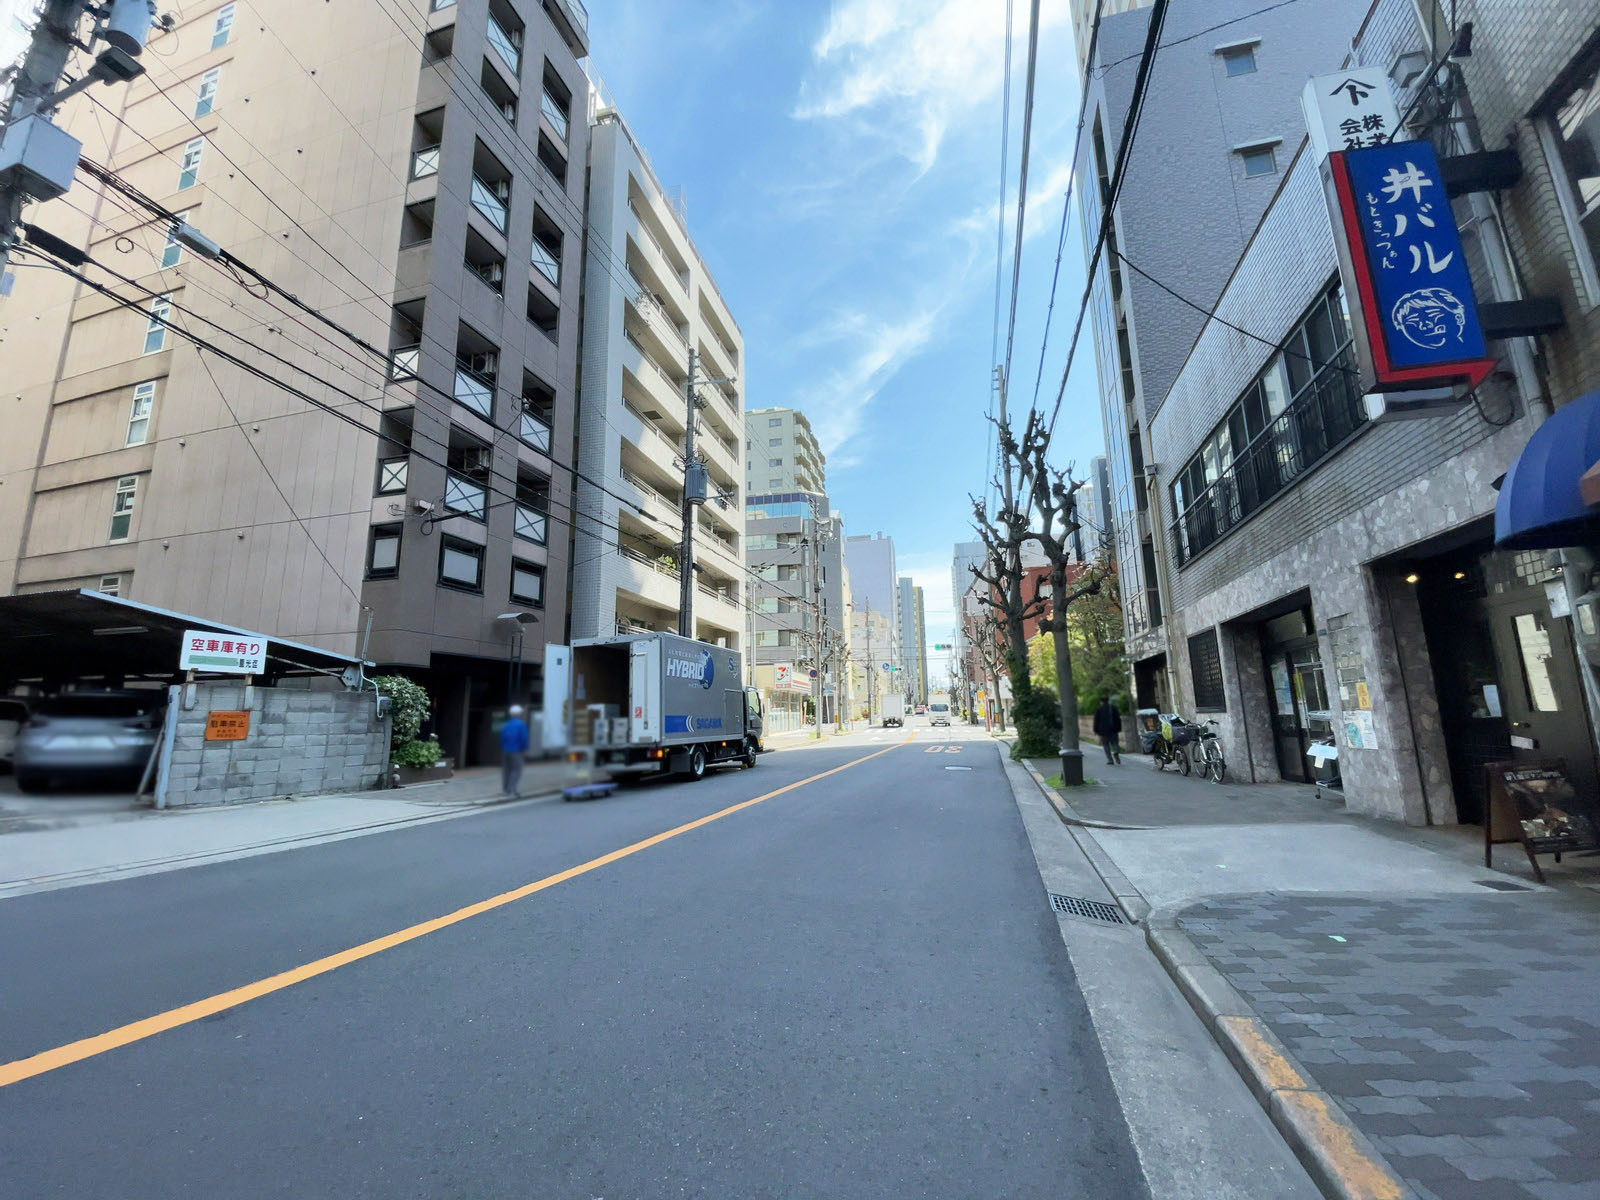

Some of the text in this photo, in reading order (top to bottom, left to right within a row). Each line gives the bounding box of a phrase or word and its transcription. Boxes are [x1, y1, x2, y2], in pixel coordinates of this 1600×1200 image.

[191, 638, 260, 656] 空車庫有り
[666, 657, 705, 681] HYBRID
